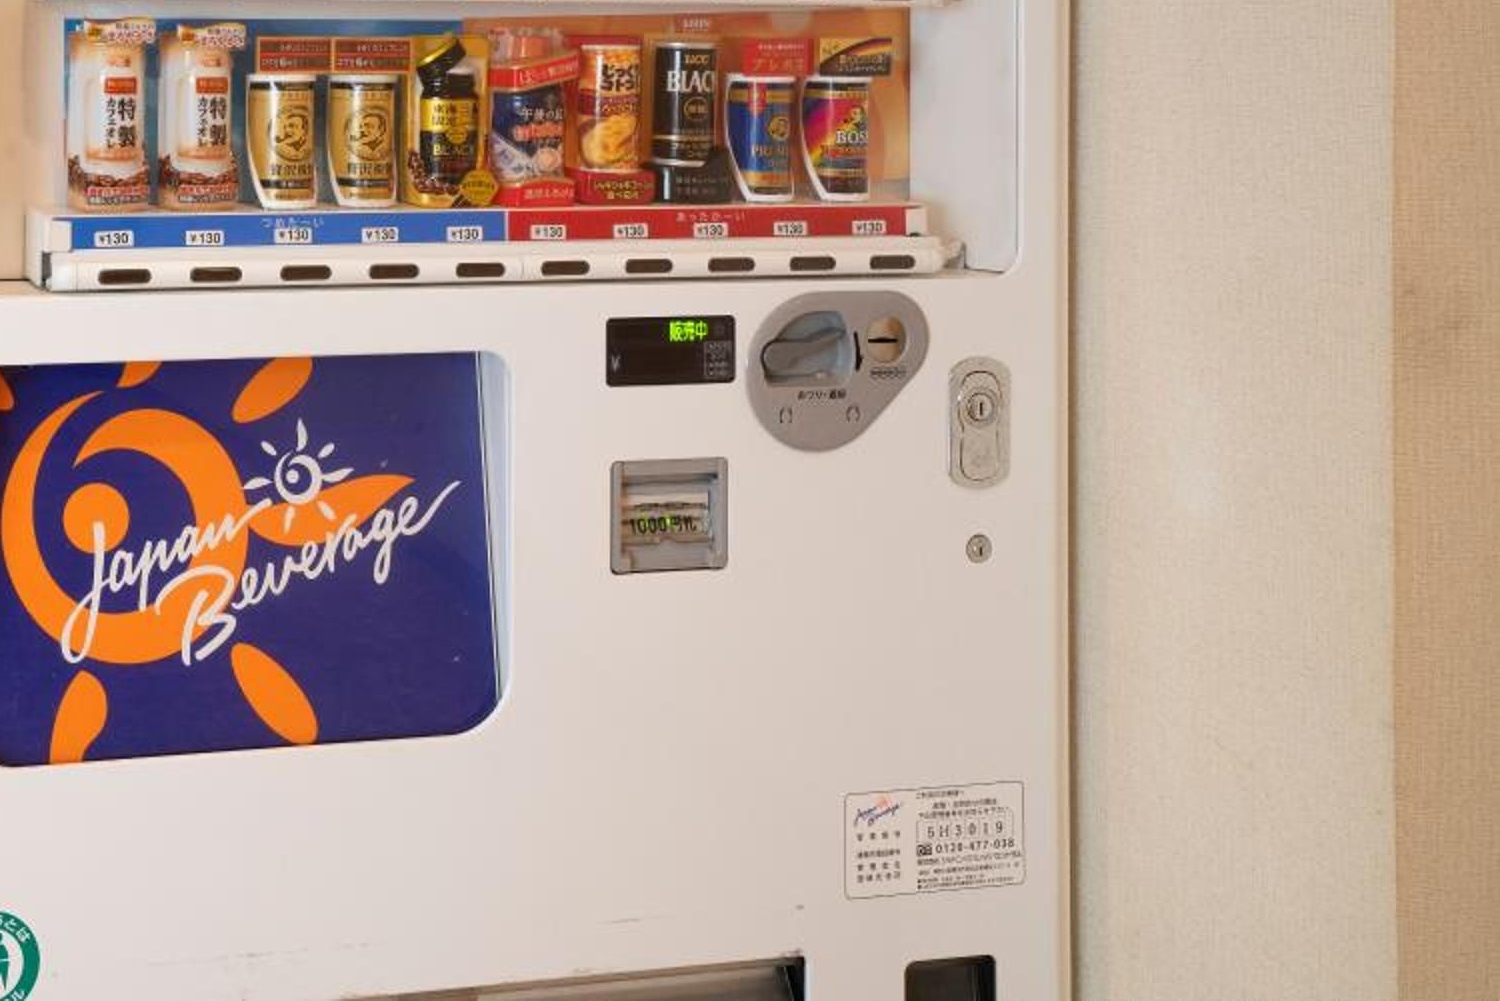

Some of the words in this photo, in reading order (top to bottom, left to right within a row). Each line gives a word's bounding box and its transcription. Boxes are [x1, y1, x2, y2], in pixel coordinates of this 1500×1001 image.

[684, 54, 709, 65] UCC
[666, 70, 715, 93] BLAC
[117, 97, 136, 148] 特製
[209, 96, 228, 147] 特製
[535, 226, 563, 237] ¥130
[696, 225, 724, 236] ¥130
[856, 222, 883, 233] ¥130
[98, 232, 129, 244] ¥130
[189, 232, 221, 244] ¥130
[278, 229, 309, 241] ¥130
[365, 229, 396, 241] ¥130
[450, 229, 479, 240] ¥130
[669, 320, 708, 342] 販売中
[153, 480, 462, 667] Beverage
[62, 499, 272, 664] Japan
